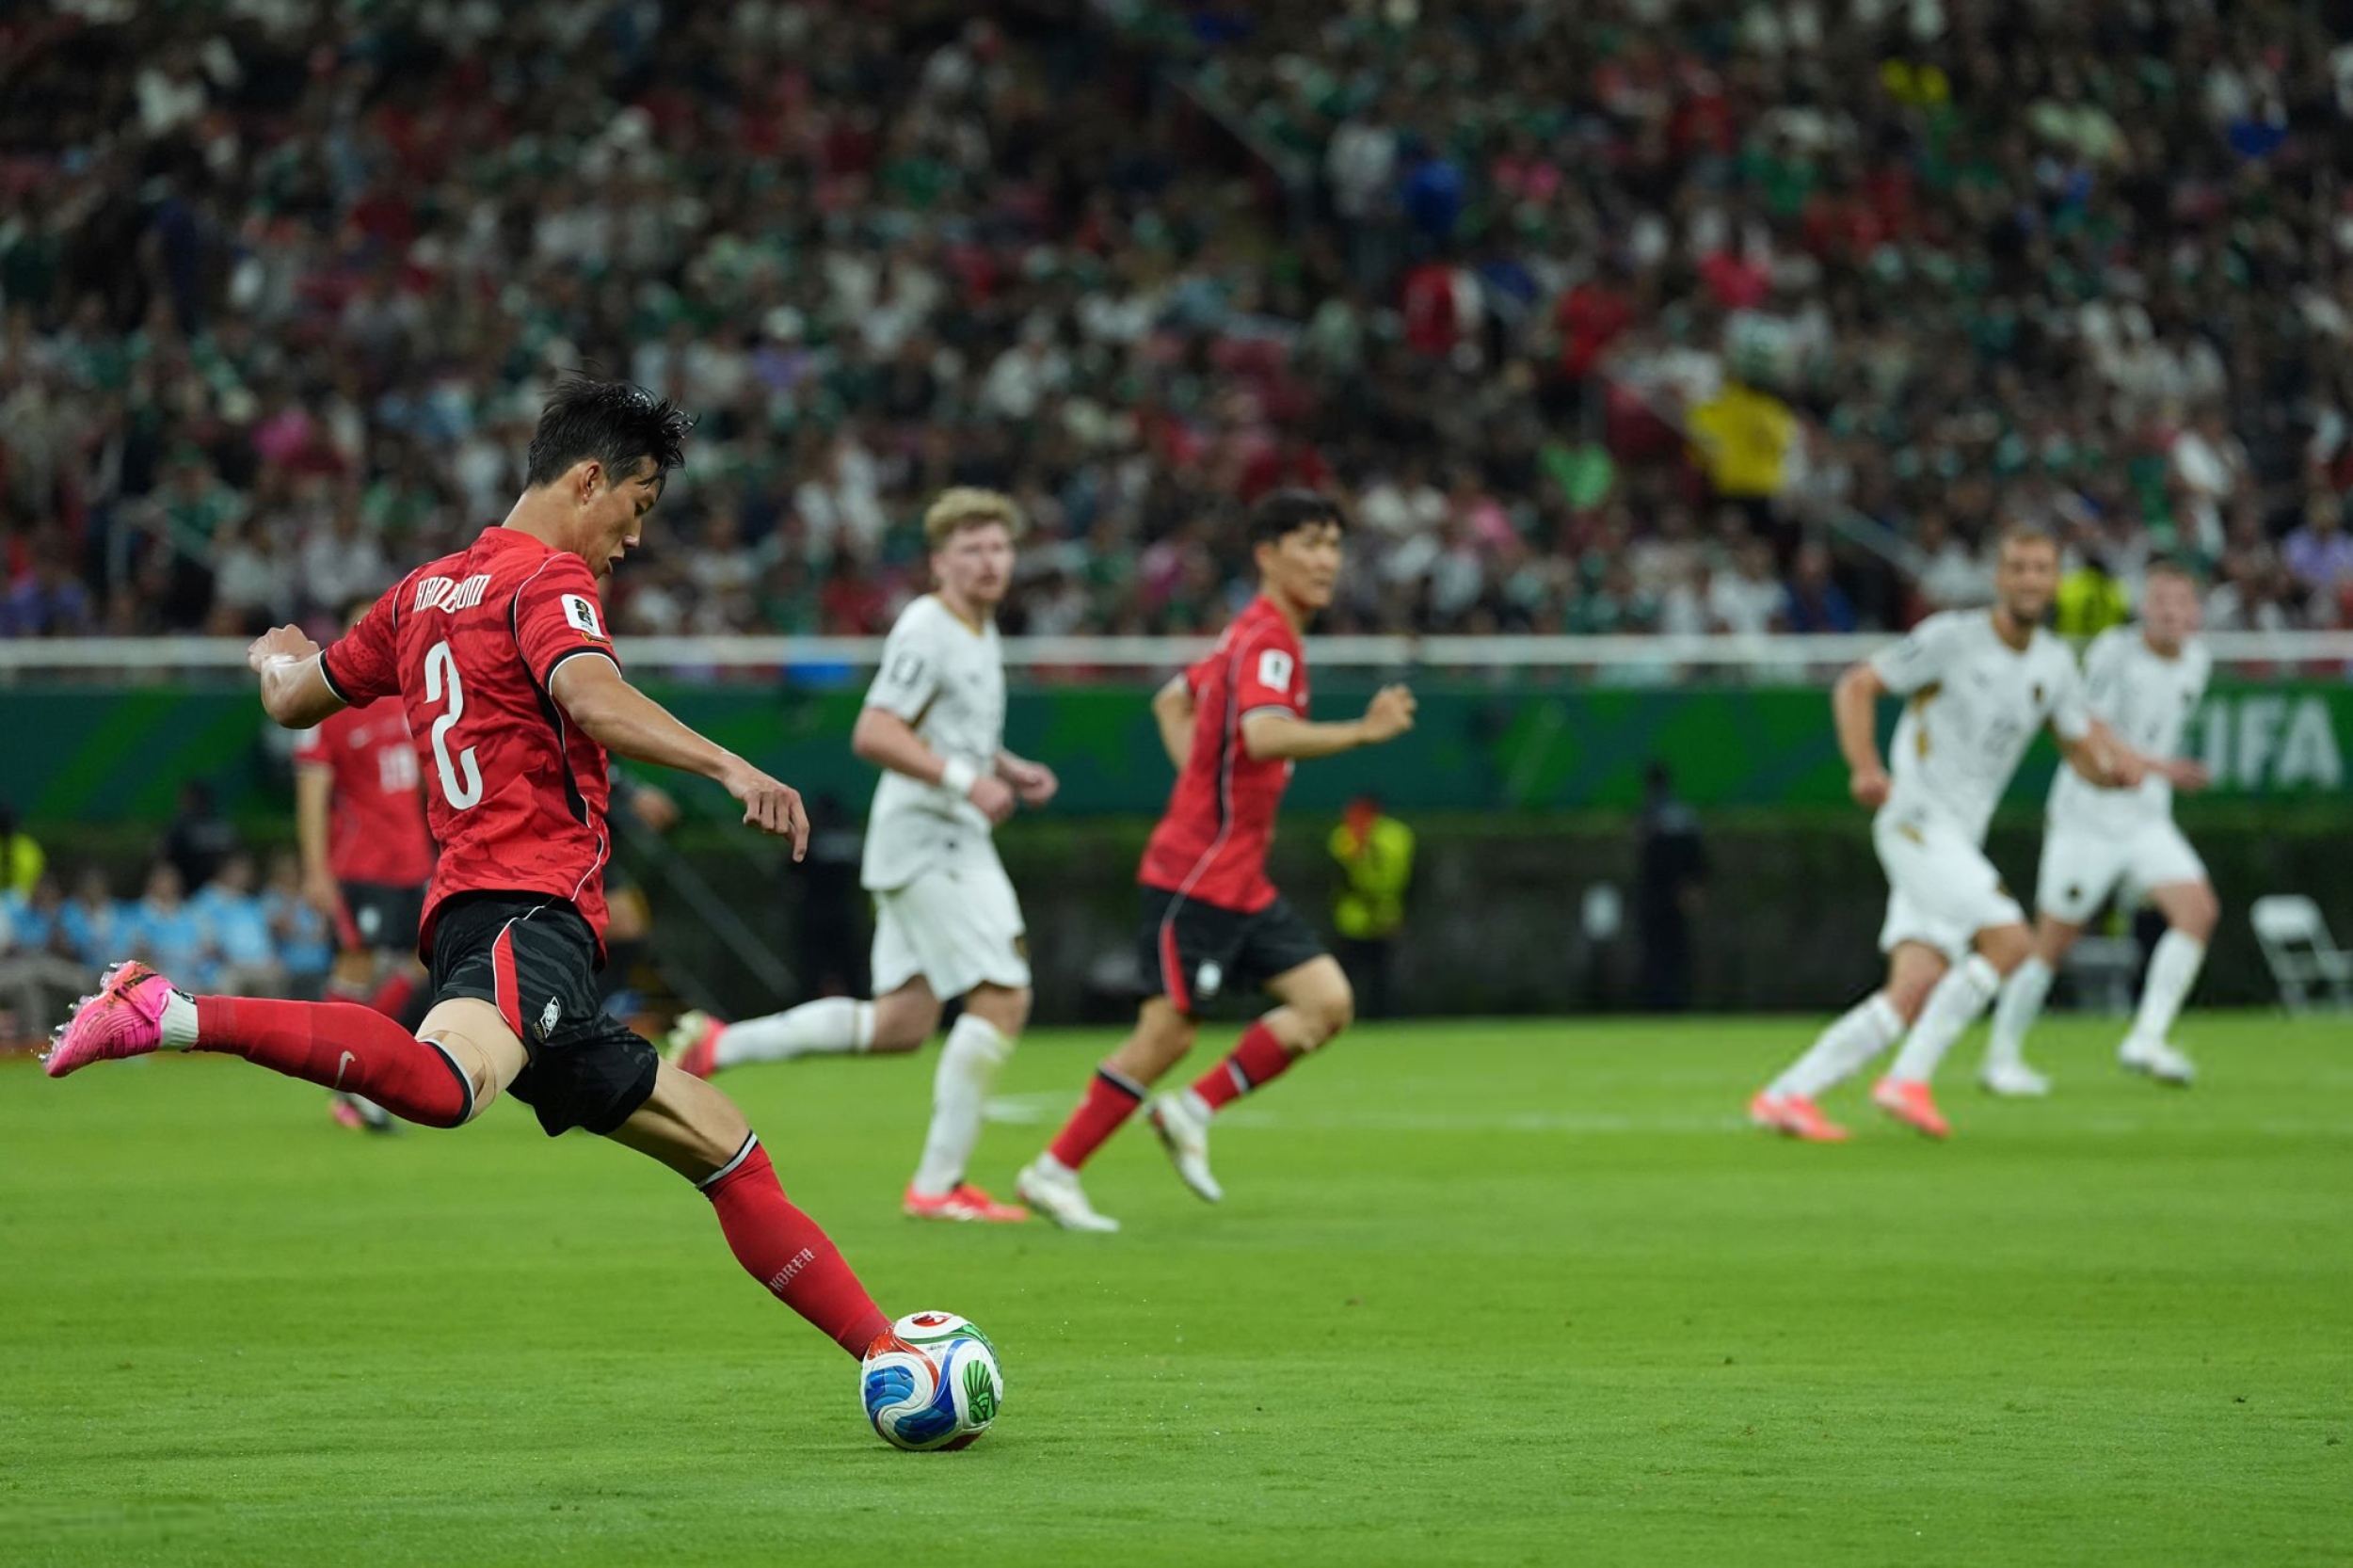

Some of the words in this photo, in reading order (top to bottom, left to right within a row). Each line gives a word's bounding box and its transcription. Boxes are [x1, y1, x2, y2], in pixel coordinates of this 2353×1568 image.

[424, 640, 483, 810] 2
[2198, 697, 2342, 789] IFA
[769, 1247, 815, 1292] KOREA
